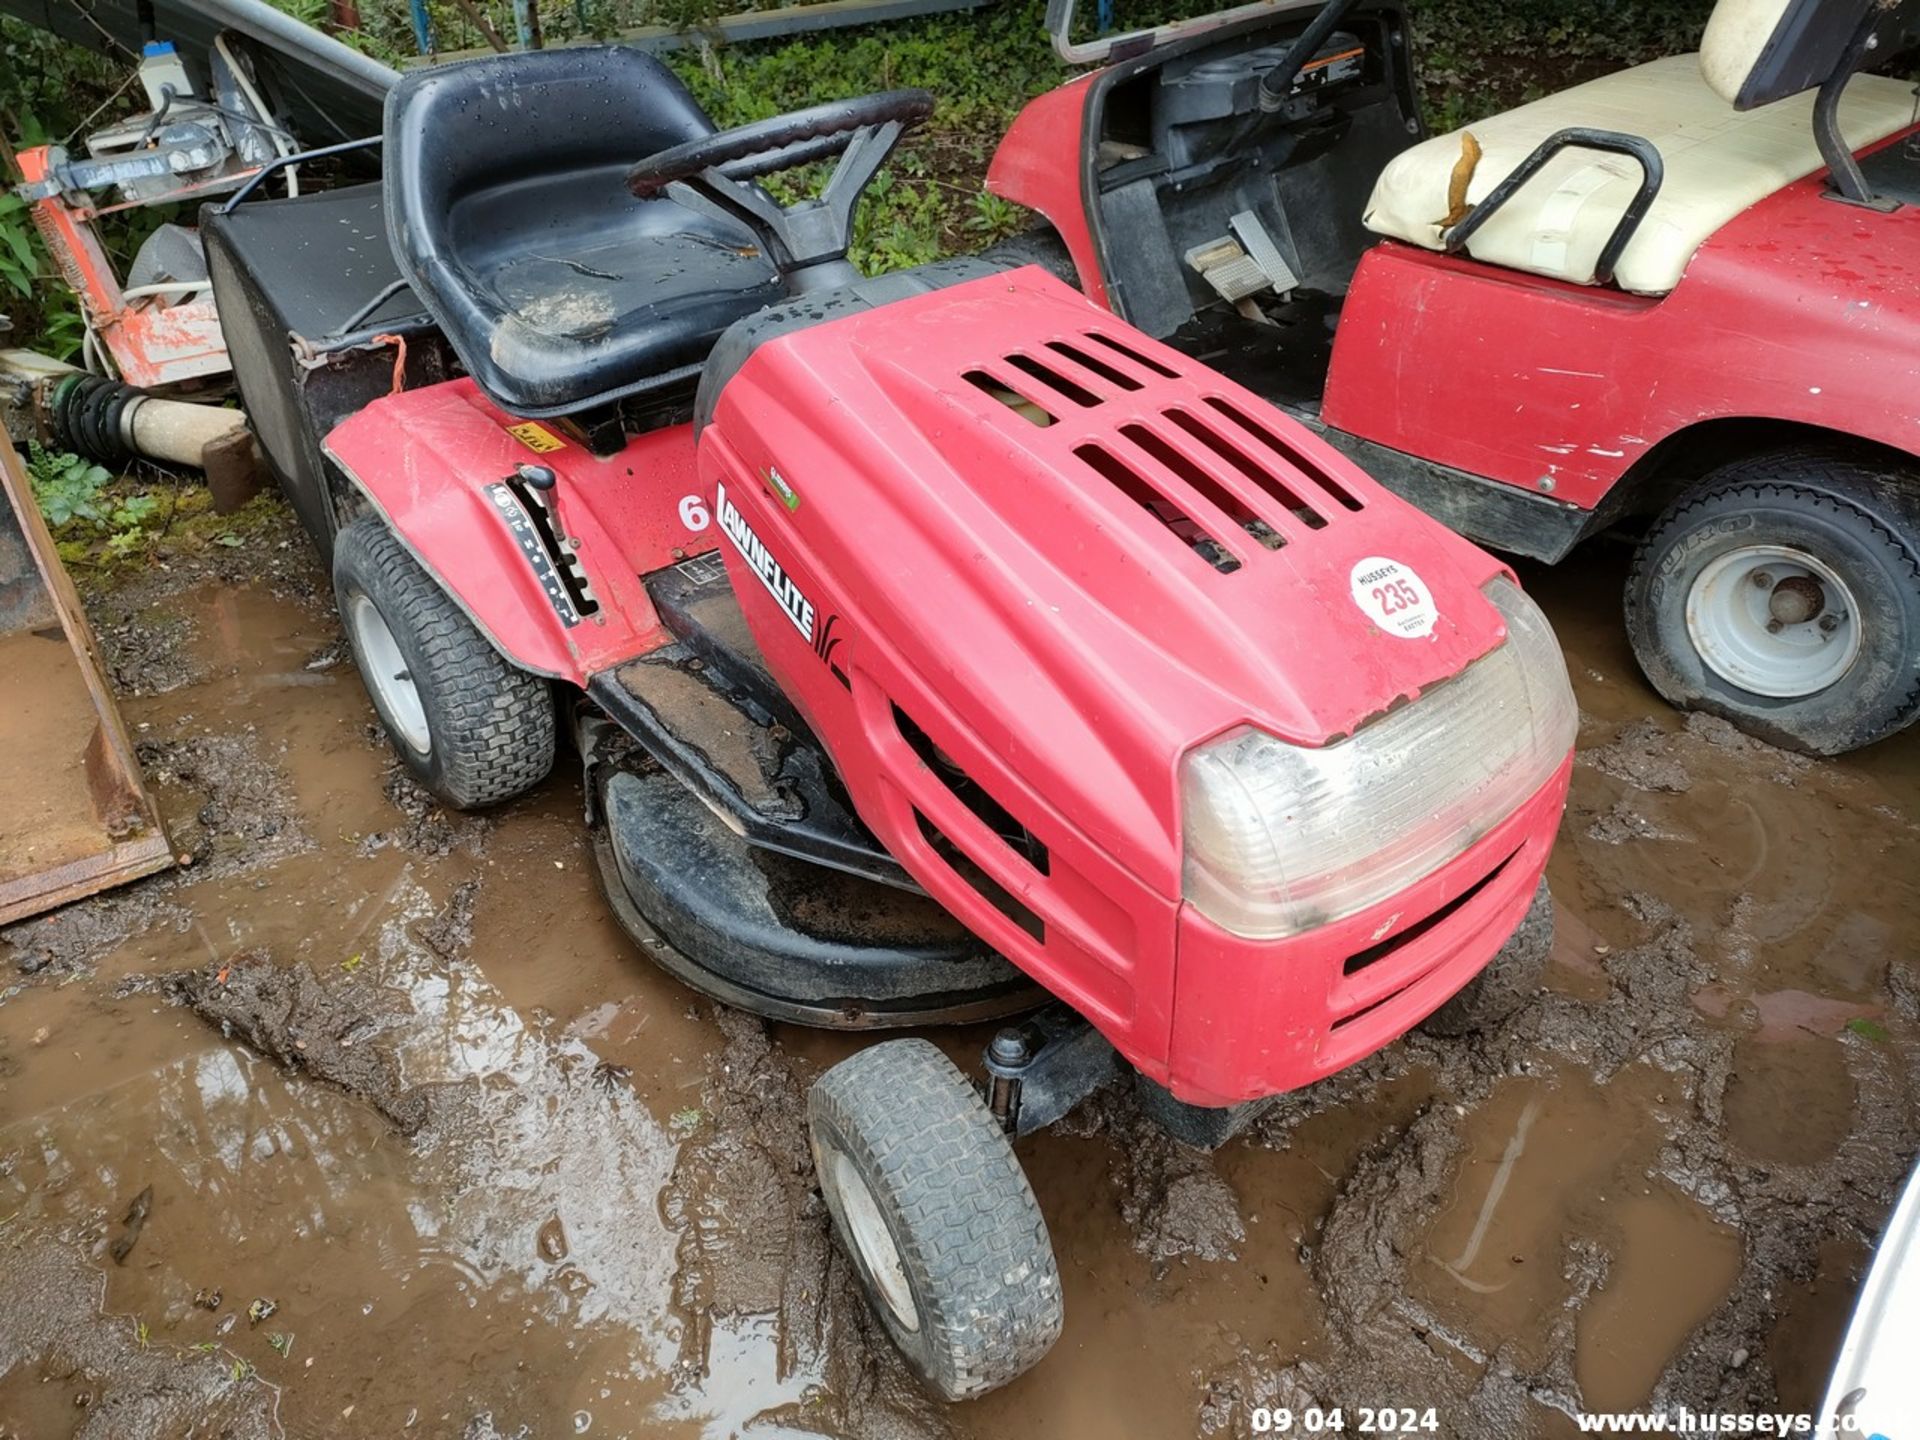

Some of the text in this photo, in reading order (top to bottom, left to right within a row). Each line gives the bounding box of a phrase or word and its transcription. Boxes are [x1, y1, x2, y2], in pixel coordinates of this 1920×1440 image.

[678, 494, 710, 532] 6
[716, 479, 815, 644] LAWNFLITE
[1358, 565, 1398, 585] HUSSEYS
[1372, 579, 1419, 615] 235
